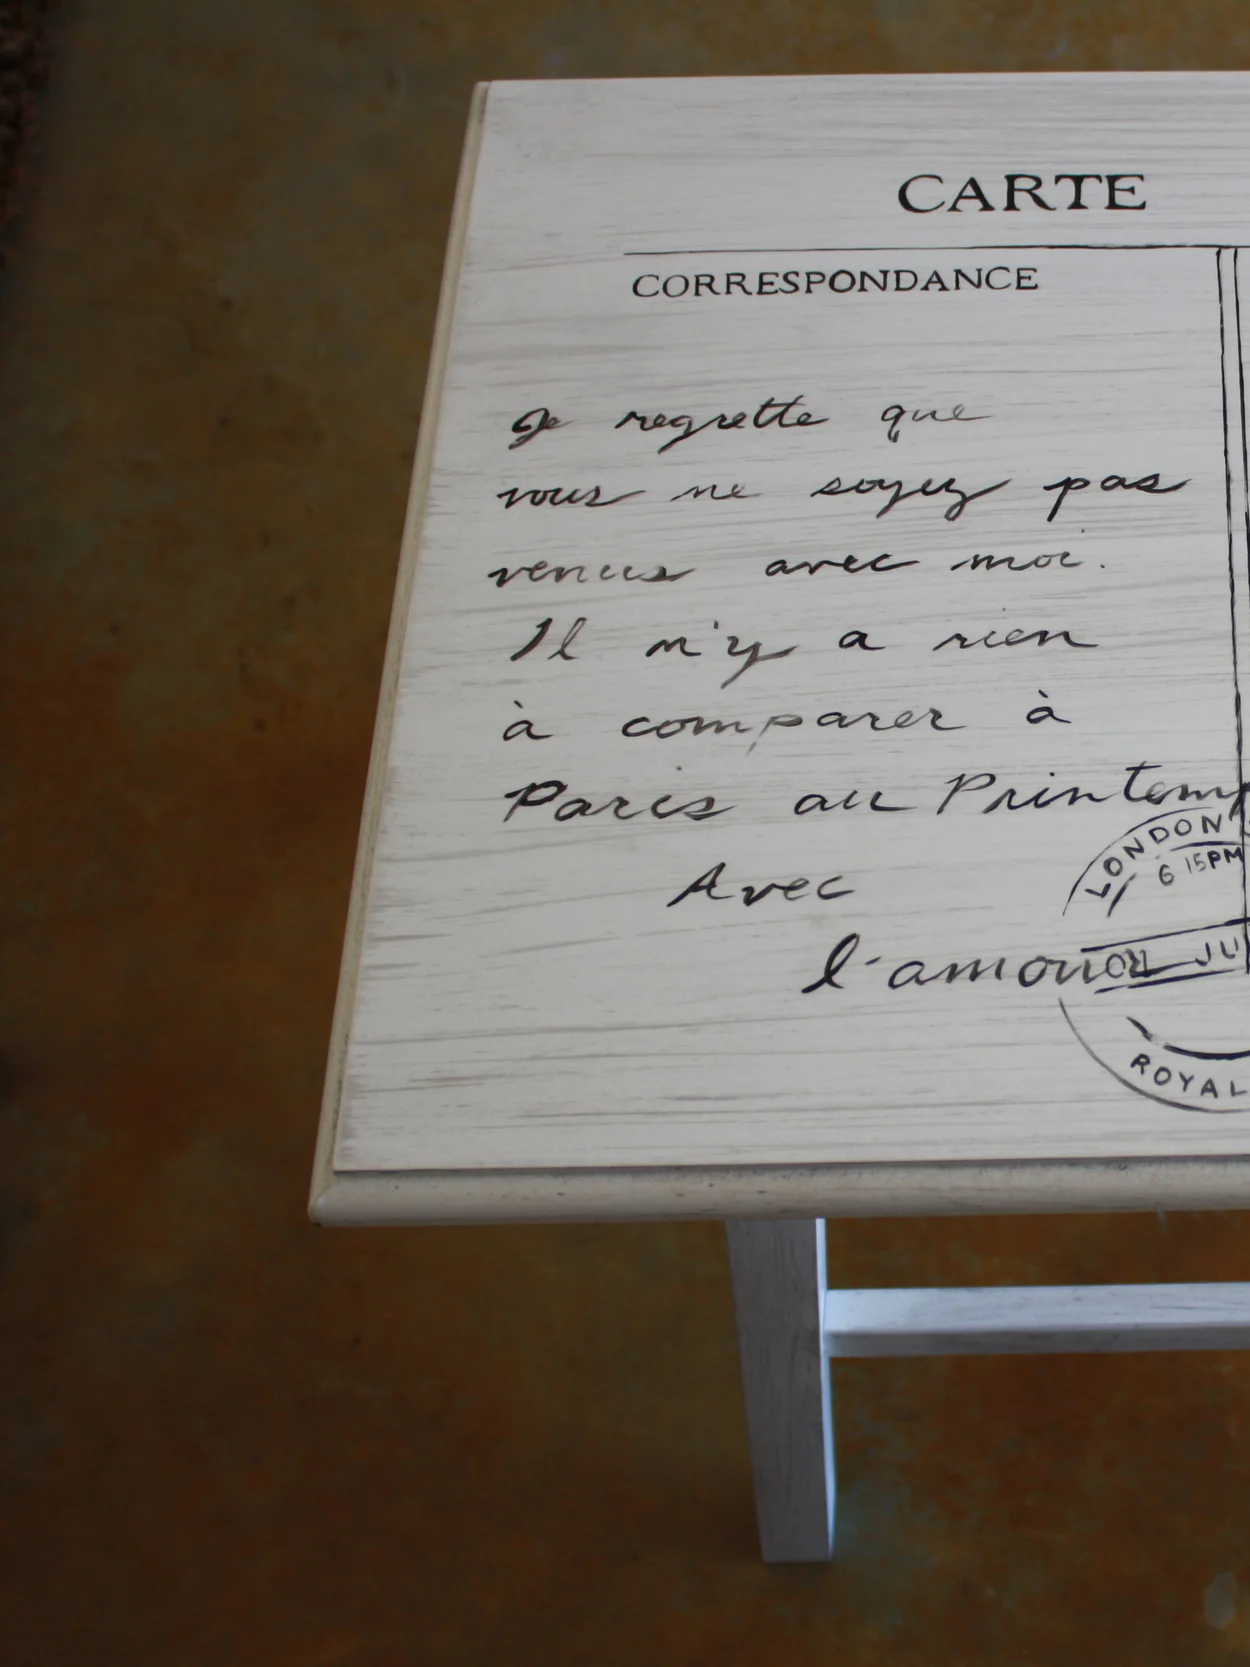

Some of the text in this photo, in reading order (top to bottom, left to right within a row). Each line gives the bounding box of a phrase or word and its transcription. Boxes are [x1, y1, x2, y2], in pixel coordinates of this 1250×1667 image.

[897, 174, 1146, 213] CARTE
[631, 267, 1039, 298] CORRESPONDANCE
[614, 395, 830, 455] regrette
[880, 403, 993, 443] que
[497, 472, 1193, 523] vous ne soyez pas
[764, 553, 920, 577] avec
[838, 629, 886, 651] a
[503, 690, 1072, 757] à comparer à
[503, 765, 737, 823] Paris
[793, 789, 918, 816] au
[1085, 813, 1222, 899] LONDON
[666, 863, 857, 909] Avec
[1130, 1053, 1248, 1099] ROYAL
